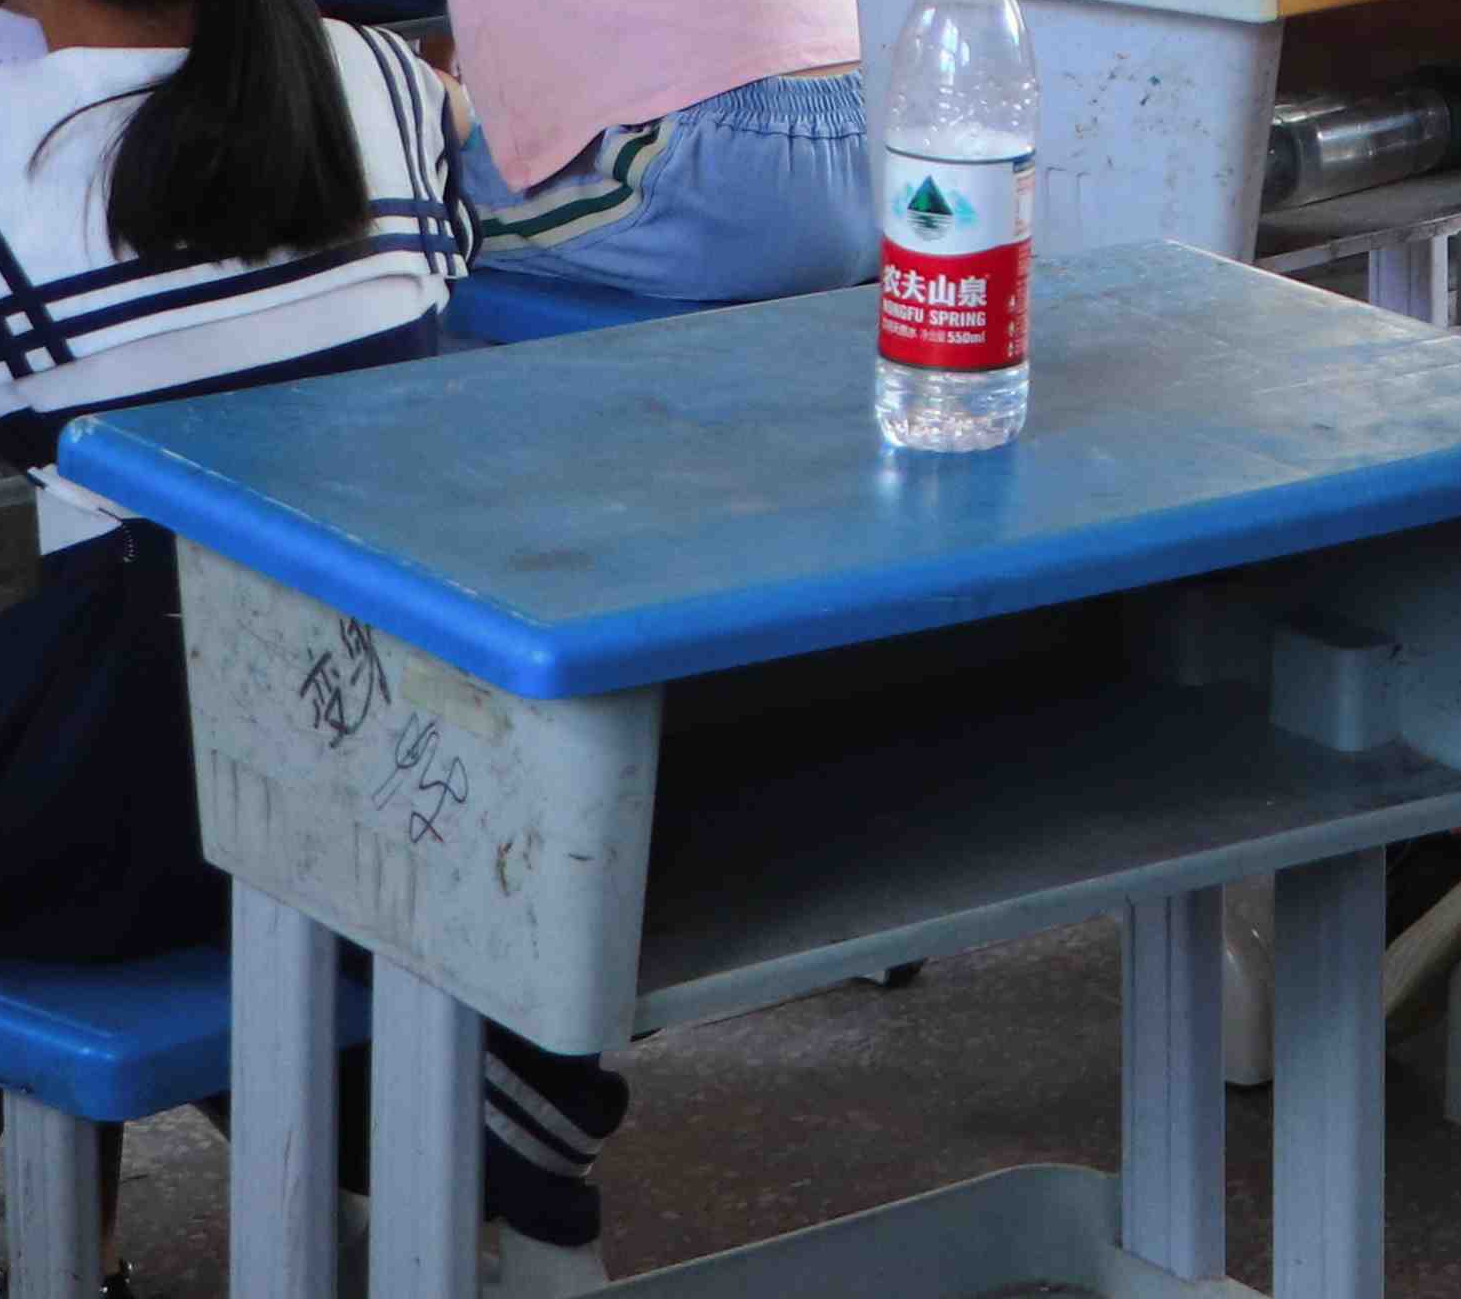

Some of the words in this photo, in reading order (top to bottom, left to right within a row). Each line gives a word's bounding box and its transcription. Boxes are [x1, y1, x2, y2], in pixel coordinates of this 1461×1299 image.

[884, 263, 988, 307] 农夫山泉
[929, 308, 987, 328] SPRING
